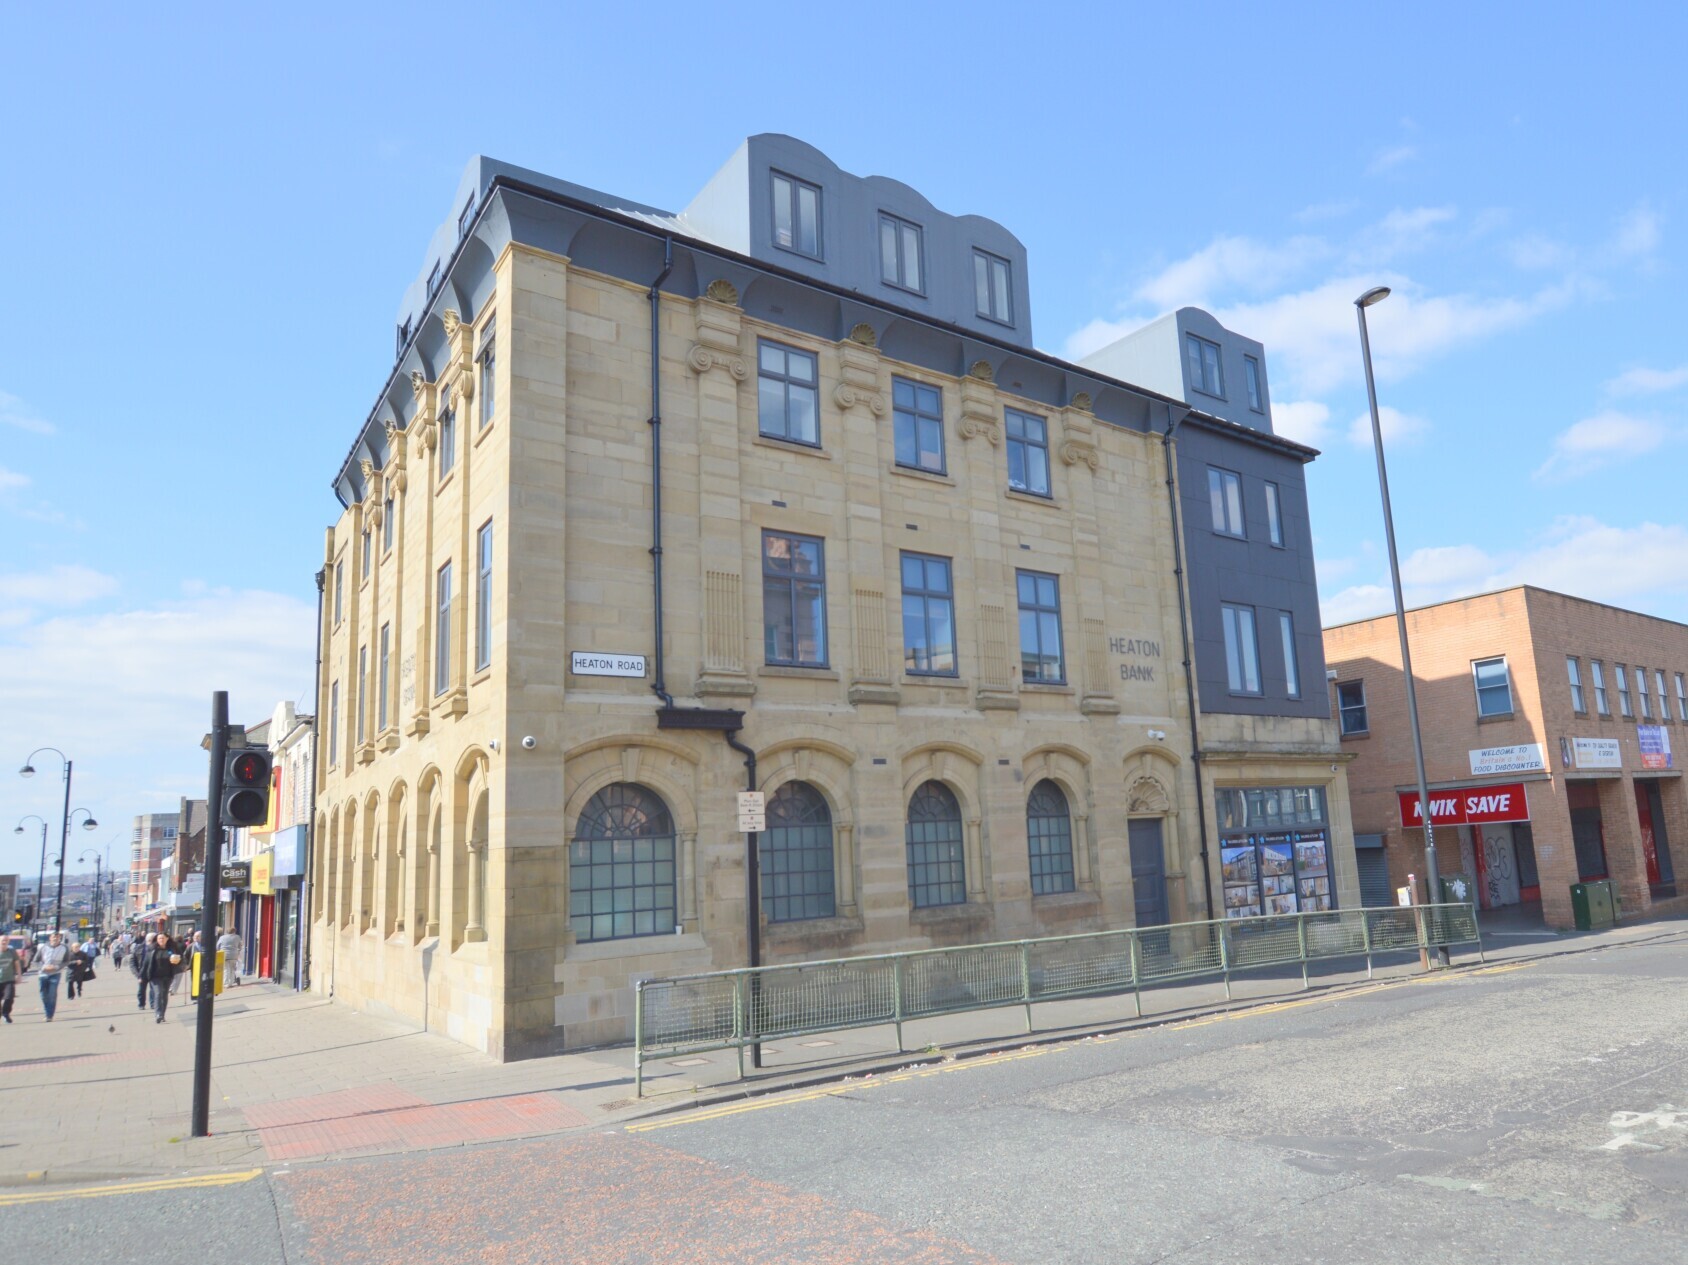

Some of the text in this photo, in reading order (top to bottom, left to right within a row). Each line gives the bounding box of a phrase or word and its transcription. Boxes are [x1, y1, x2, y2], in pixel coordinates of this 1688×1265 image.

[1109, 637, 1161, 658] HEATON
[574, 658, 643, 671] HEATON ROAD
[1120, 664, 1155, 682] BANK
[1481, 746, 1528, 757] WELCOME TO
[1473, 761, 1540, 773] FOOD DISCOUNTER
[1466, 794, 1511, 814] SAVE
